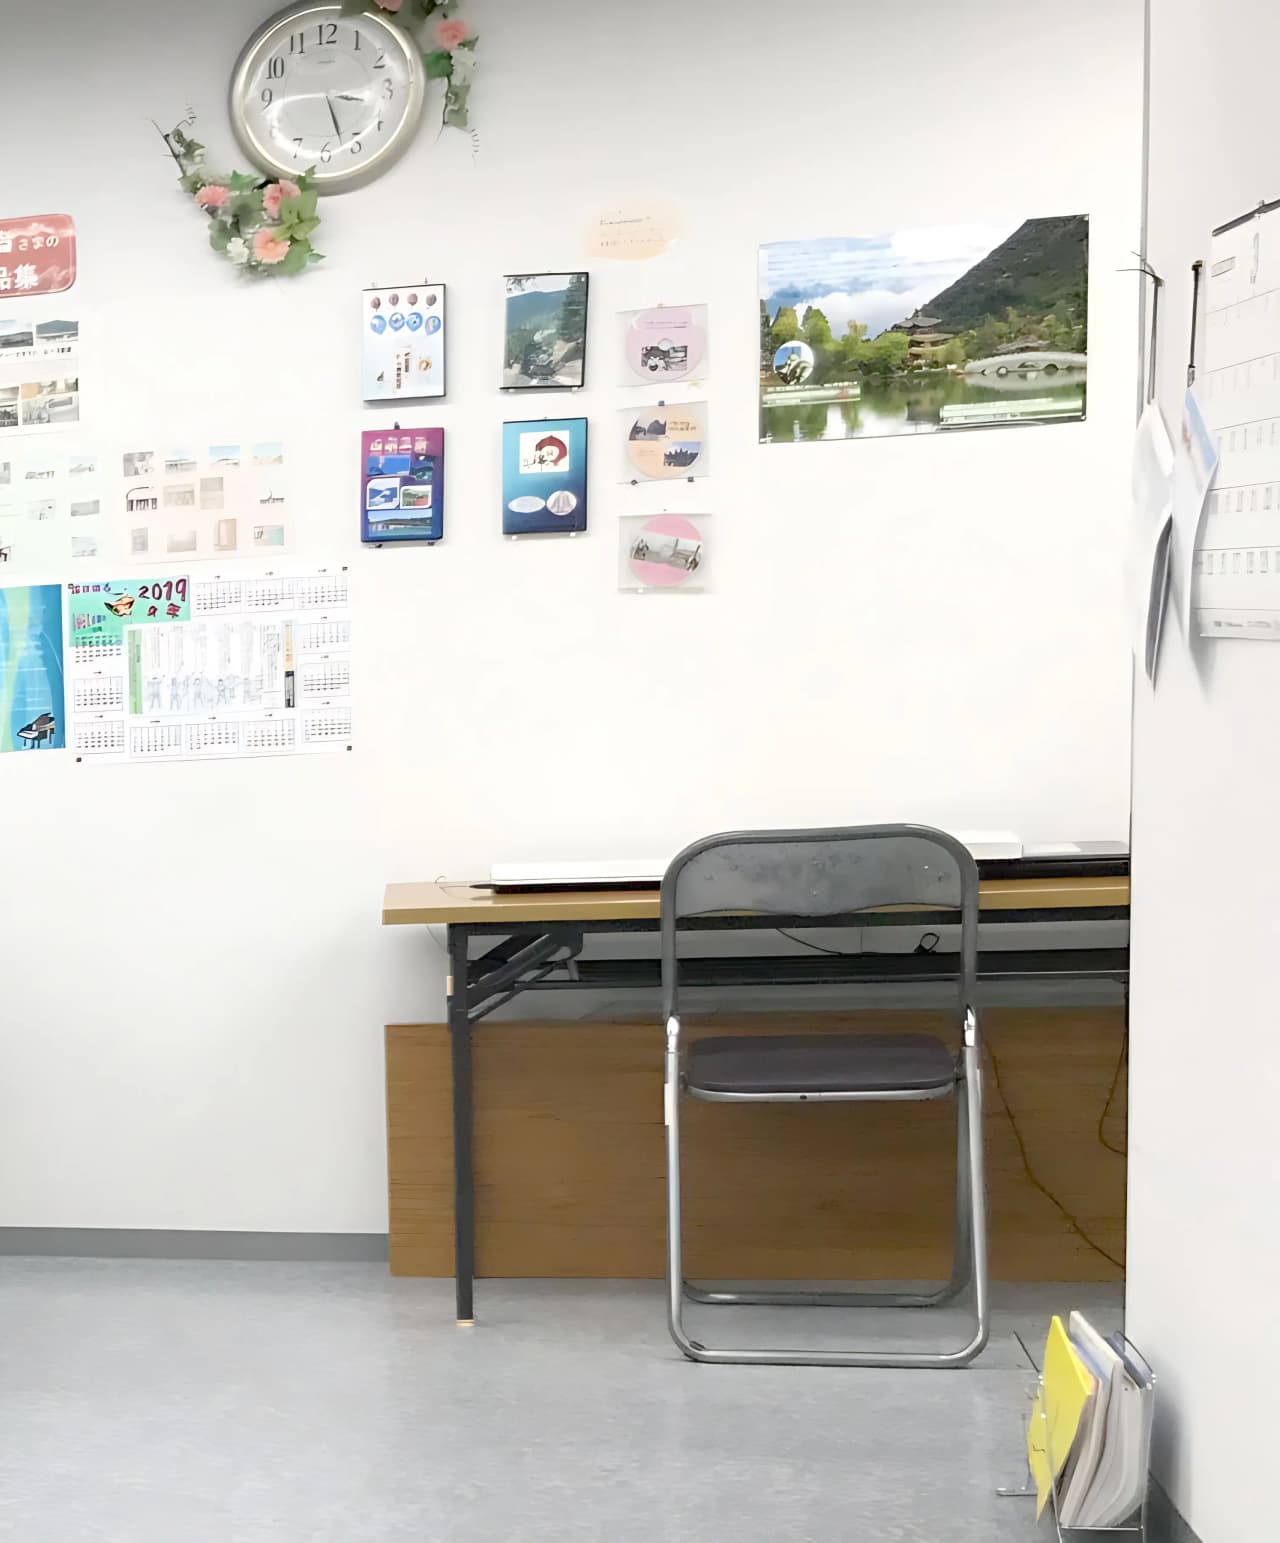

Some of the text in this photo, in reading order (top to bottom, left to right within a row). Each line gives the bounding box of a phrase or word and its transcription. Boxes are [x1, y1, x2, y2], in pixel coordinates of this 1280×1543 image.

[288, 32, 305, 54] 11
[315, 23, 337, 46] 12
[354, 29, 361, 51] 1
[266, 56, 285, 79] 10
[261, 87, 273, 111] 9
[383, 77, 393, 100] 3
[320, 141, 331, 163] 6
[138, 578, 188, 603] 2019
